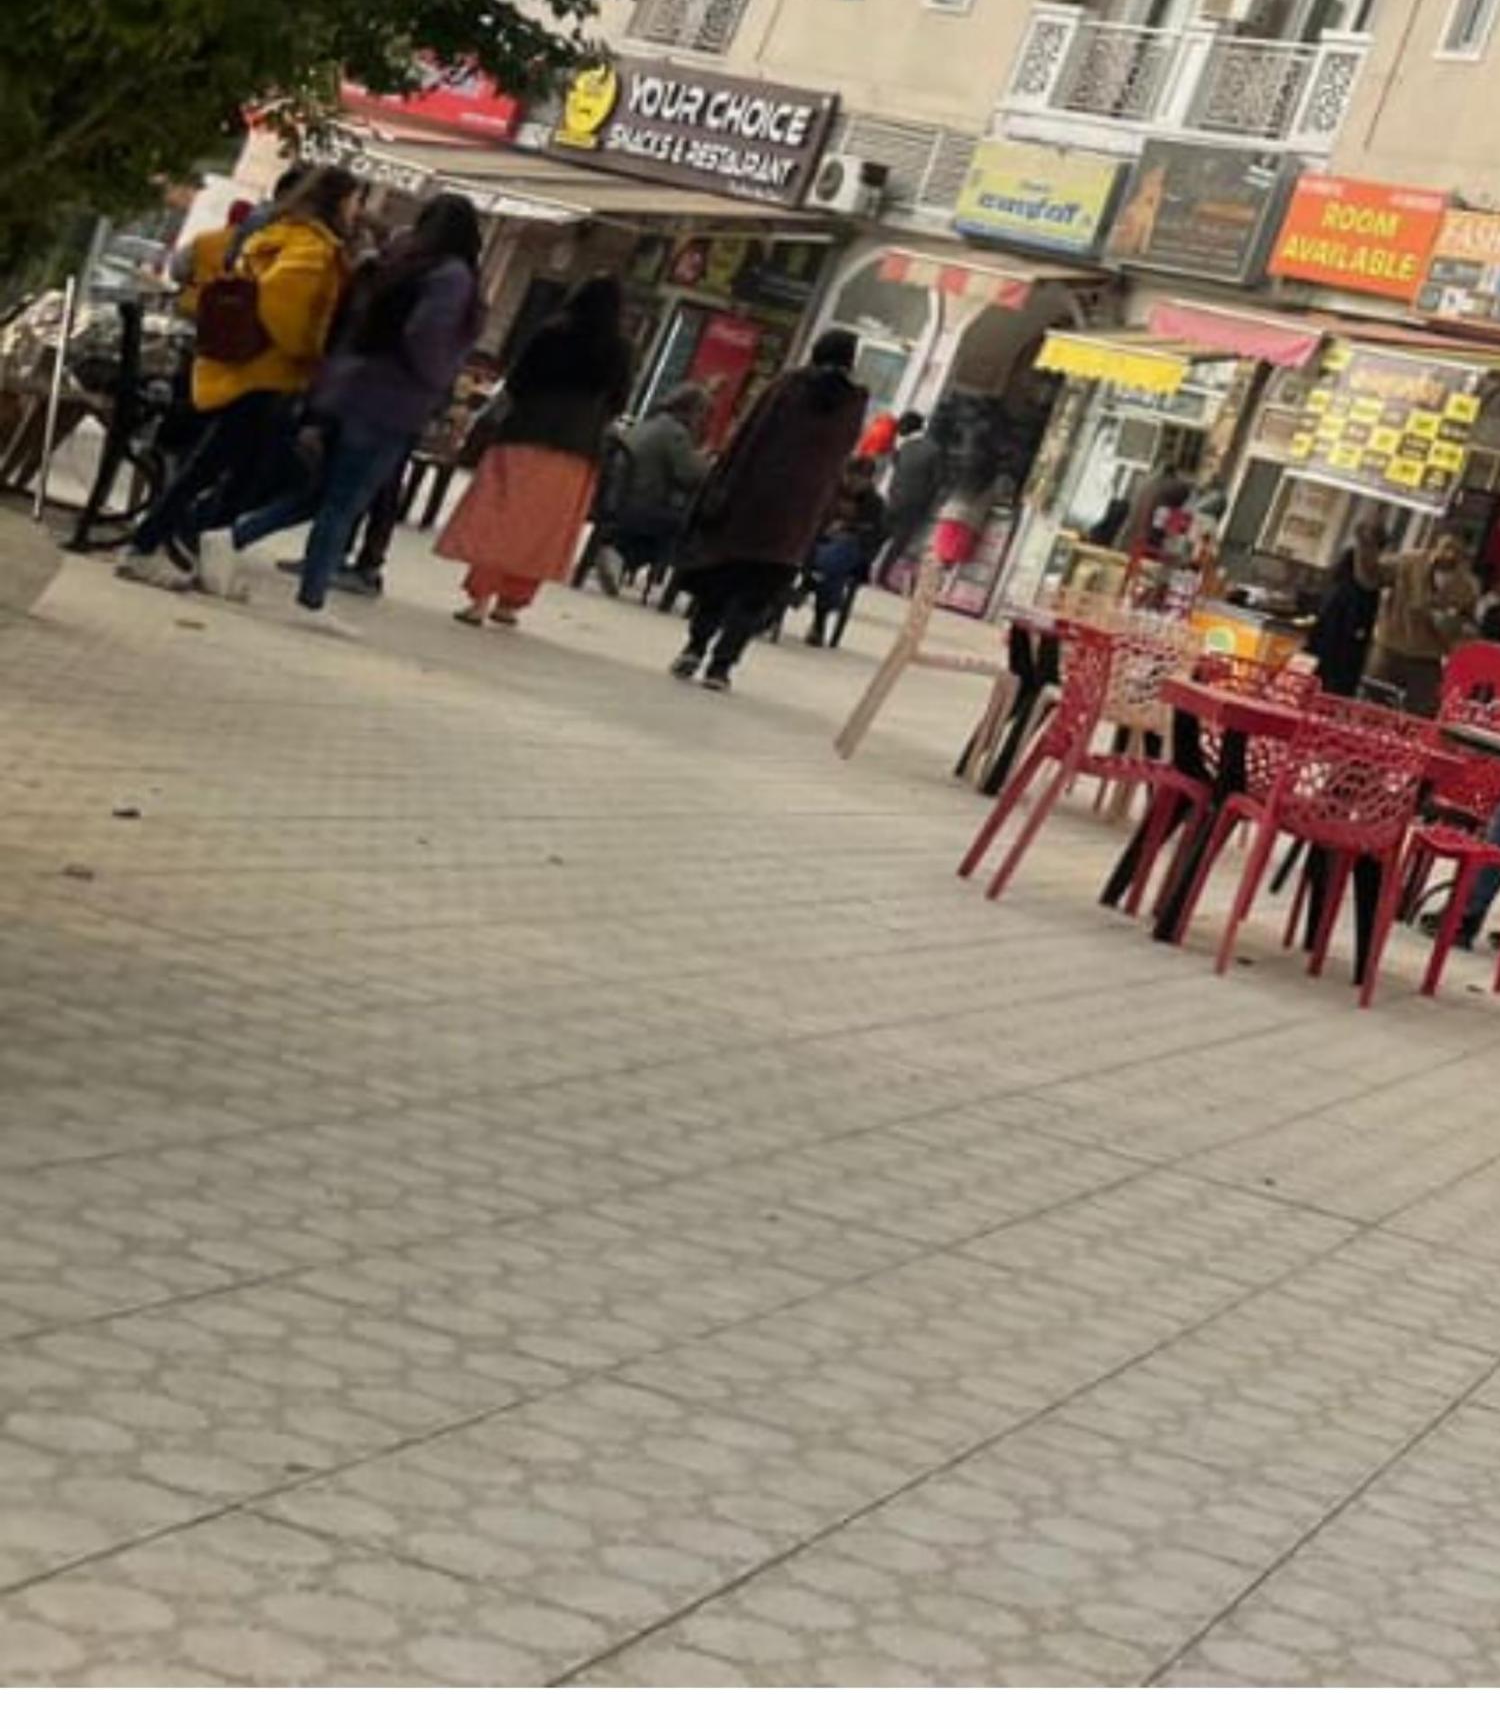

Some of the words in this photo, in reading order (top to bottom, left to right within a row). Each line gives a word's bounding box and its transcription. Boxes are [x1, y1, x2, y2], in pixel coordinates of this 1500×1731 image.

[628, 72, 704, 124] YOUR
[706, 91, 812, 147] CHOICE
[605, 123, 672, 161] SNACKS
[685, 141, 797, 187] RESTAURANT
[1321, 201, 1398, 238] ROOM
[1282, 235, 1419, 282] AVAILABLE
